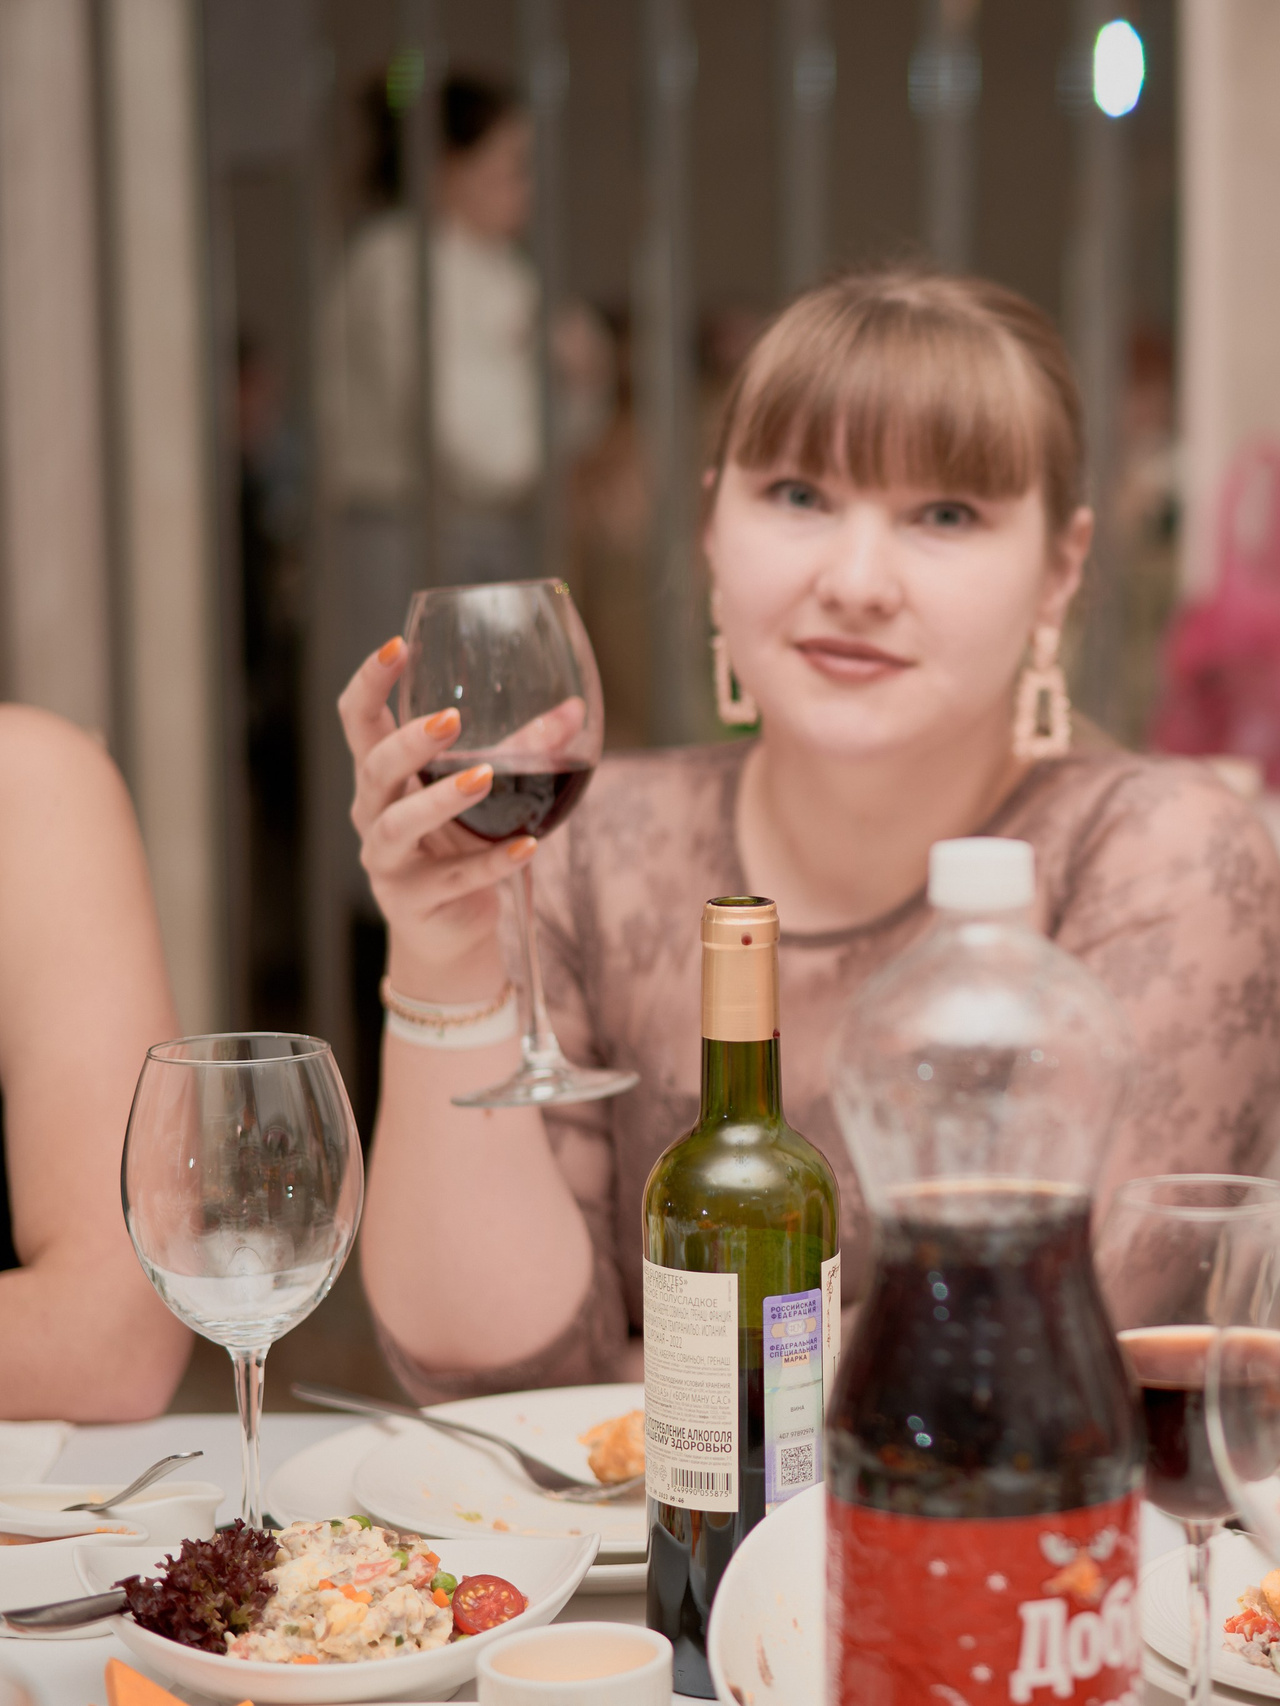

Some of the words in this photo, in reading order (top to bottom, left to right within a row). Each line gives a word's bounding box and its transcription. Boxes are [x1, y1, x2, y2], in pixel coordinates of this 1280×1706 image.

[660, 1291, 718, 1308] ПОЛУСЛАДКОЕ
[770, 1299, 817, 1313] РОССИЙСКАЯ
[770, 1306, 817, 1320] ФЕДЕРАЦИЯ
[669, 1334, 683, 1349] 2022
[769, 1337, 818, 1351] ФЕДЕРАЛЬНАЯ
[769, 1343, 818, 1358] СПЕЦИАЛЬНАЯ
[783, 1354, 808, 1364] МАРКА
[790, 1404, 805, 1413] ВИНА
[646, 1416, 685, 1440] ПОТРЕБЛЕНИЕ
[687, 1428, 732, 1443] АЛКОГОЛЯ
[671, 1437, 732, 1453] ЗДОРОВЬЮ
[673, 1486, 698, 1496] 249990
[700, 1489, 729, 1498] 055875
